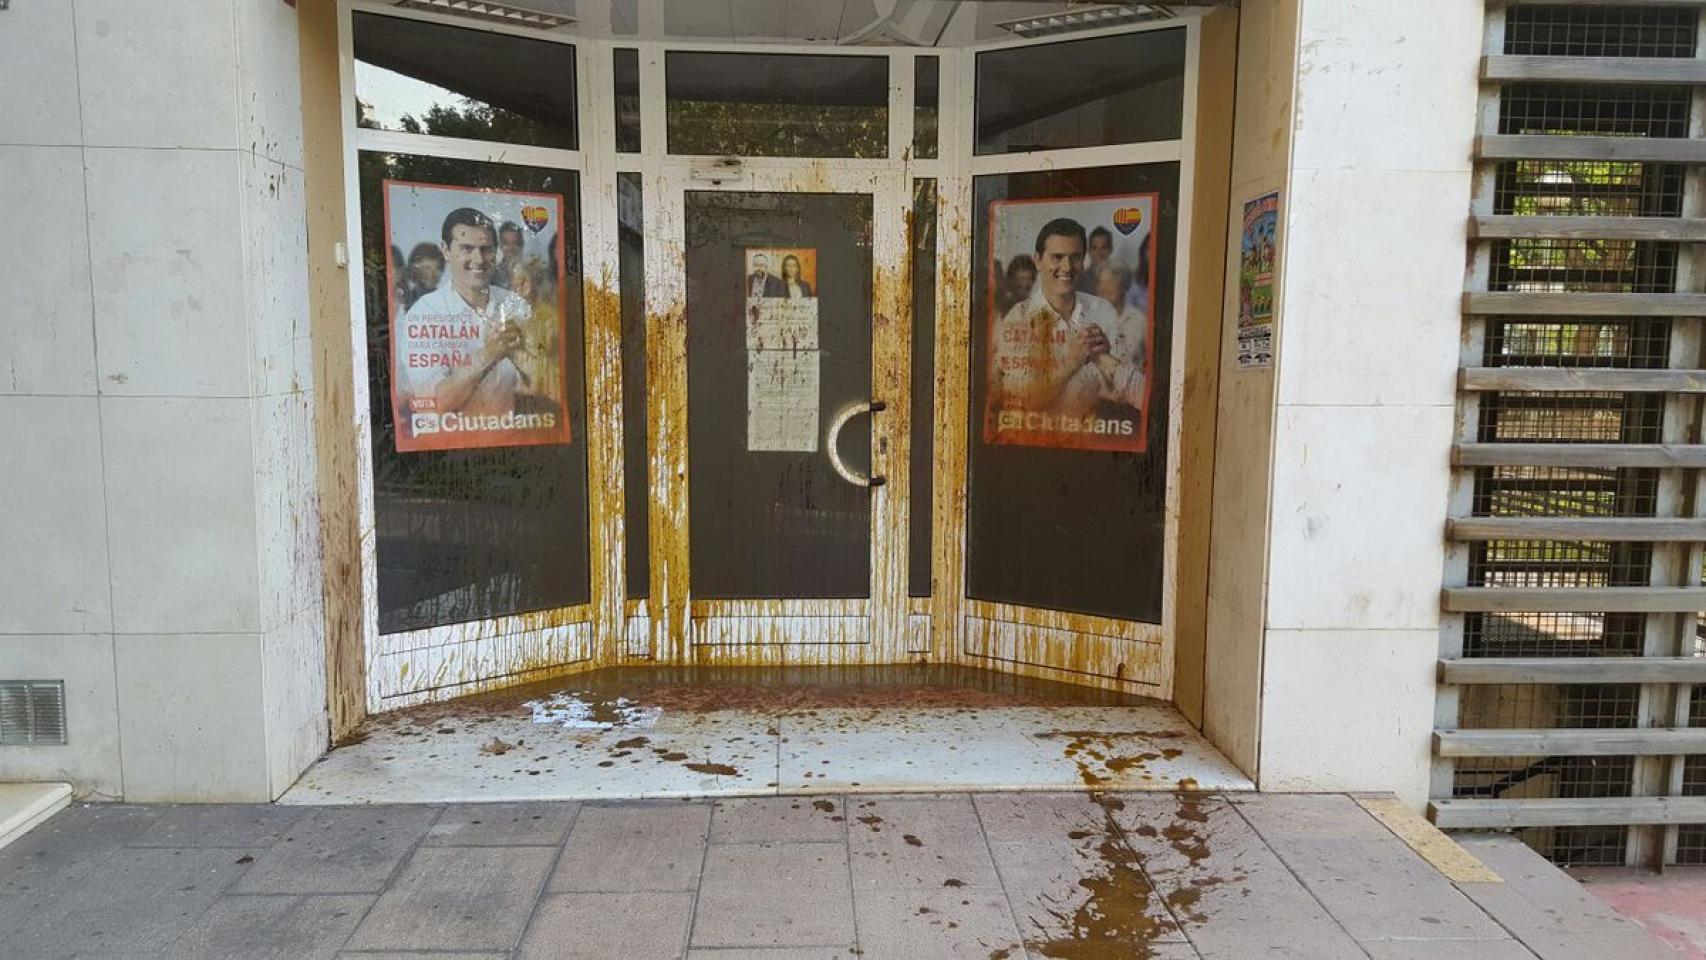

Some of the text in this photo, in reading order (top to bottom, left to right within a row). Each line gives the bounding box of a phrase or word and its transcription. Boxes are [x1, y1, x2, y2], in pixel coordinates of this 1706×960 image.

[408, 320, 480, 339] CATALÁN
[408, 349, 472, 368] ESPAÑA
[441, 411, 556, 432] Ciutadans
